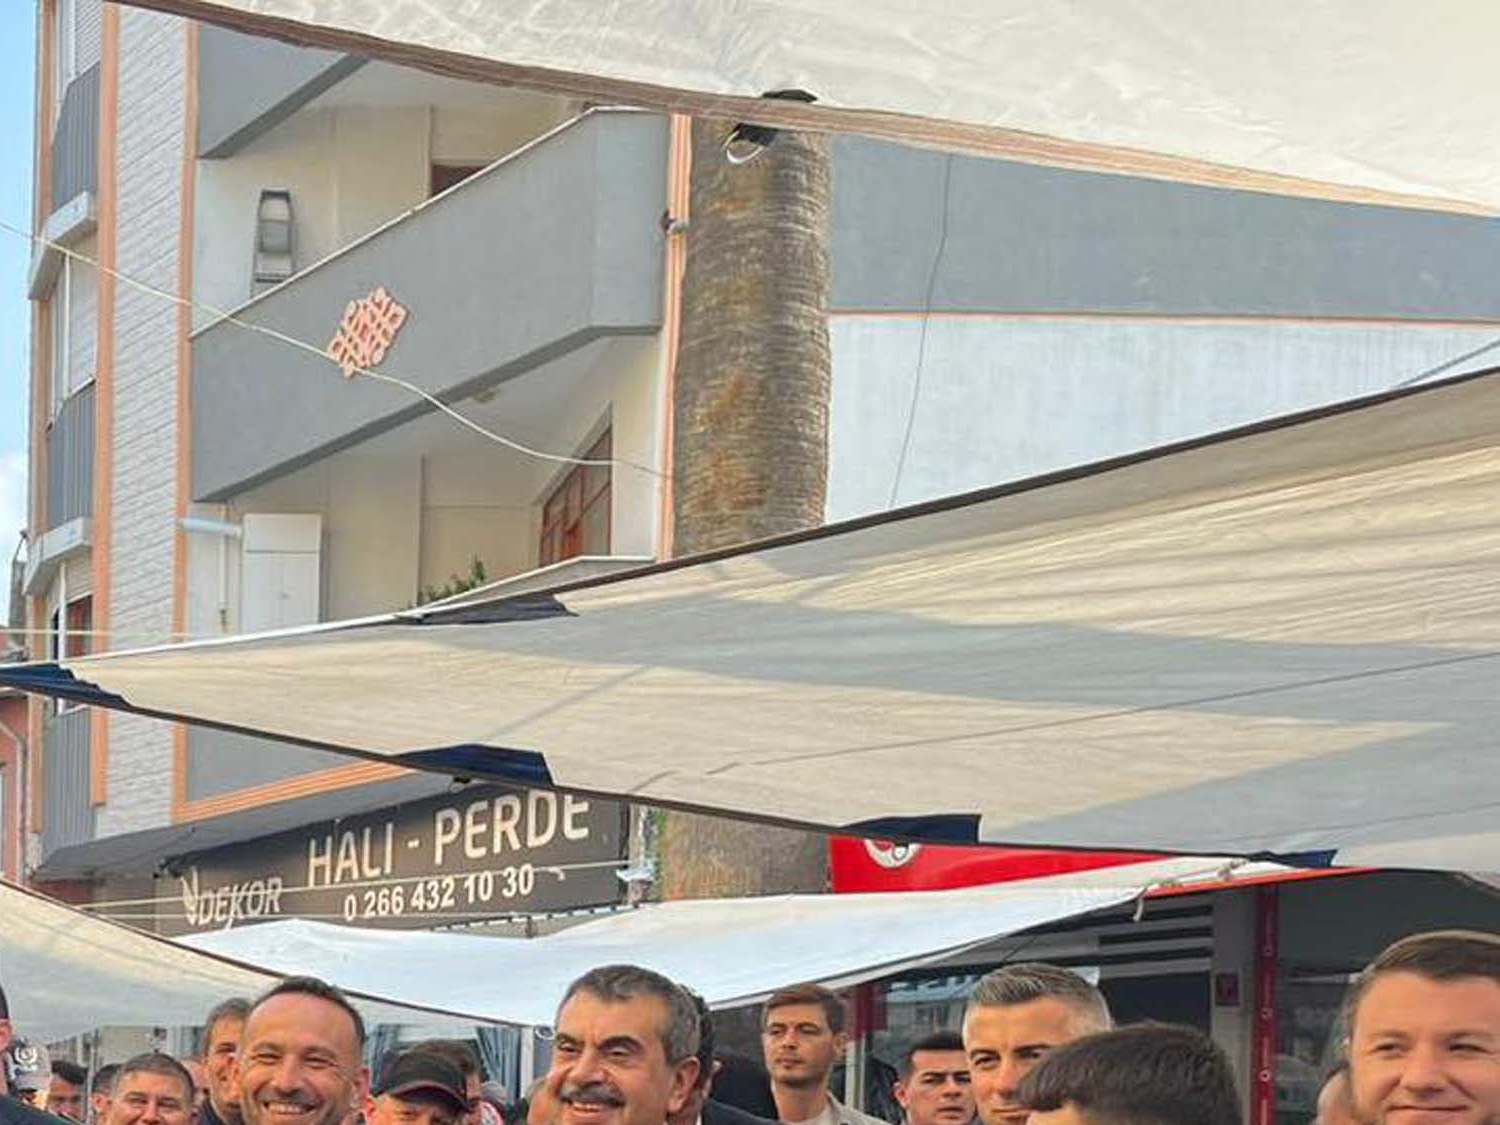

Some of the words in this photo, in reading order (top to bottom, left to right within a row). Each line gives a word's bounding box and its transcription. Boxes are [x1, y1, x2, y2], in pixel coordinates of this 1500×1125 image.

[307, 821, 394, 888] HALI
[433, 788, 591, 866] PERDE
[343, 894, 359, 922] 0
[363, 885, 405, 919] 266
[410, 876, 456, 912] 432
[463, 868, 494, 904] 10
[501, 863, 535, 898] 30
